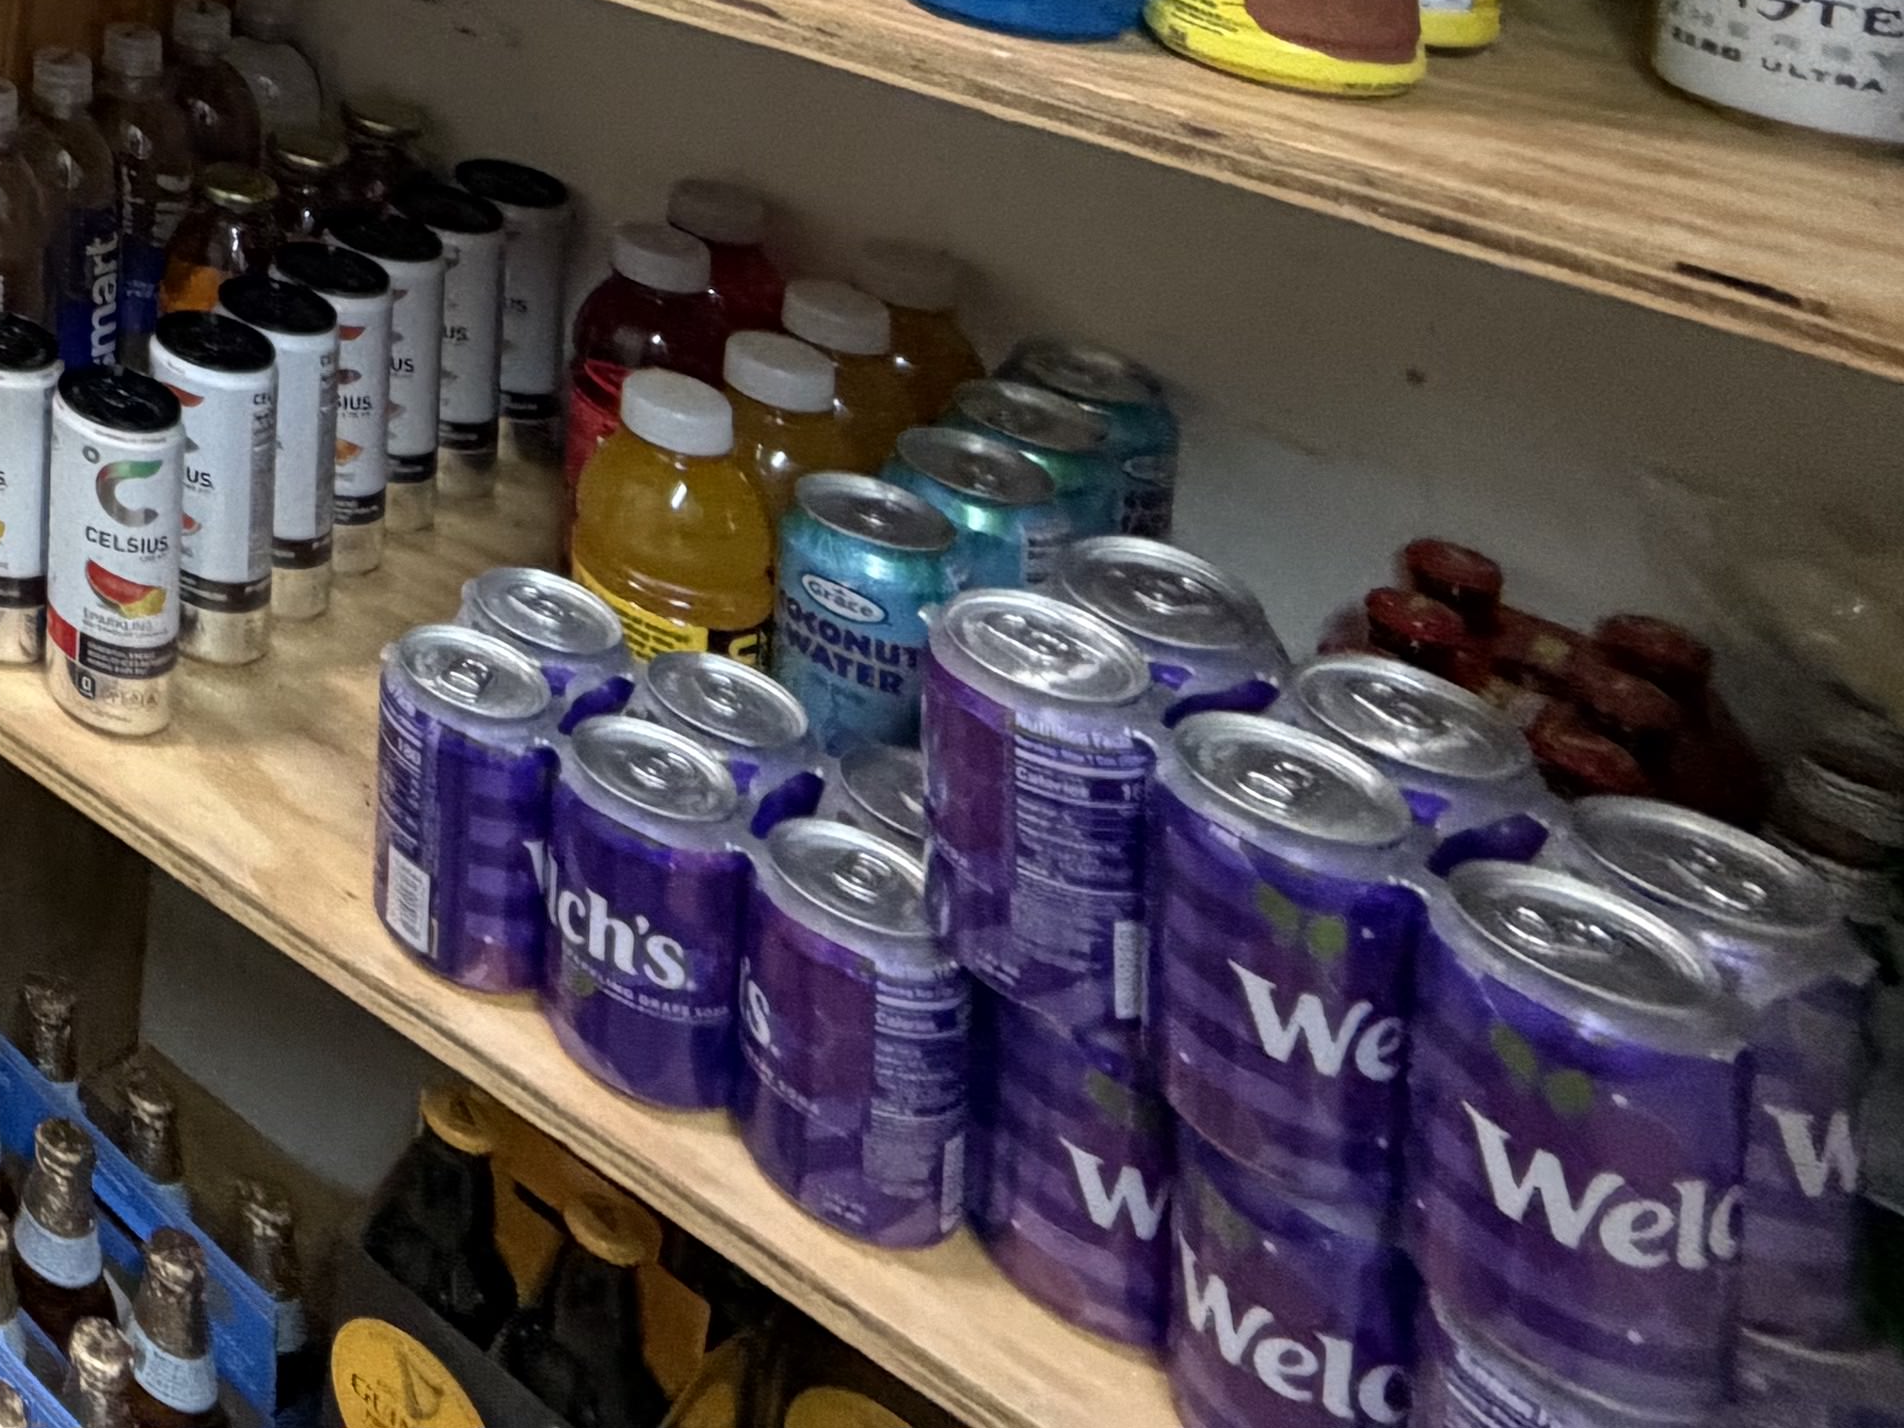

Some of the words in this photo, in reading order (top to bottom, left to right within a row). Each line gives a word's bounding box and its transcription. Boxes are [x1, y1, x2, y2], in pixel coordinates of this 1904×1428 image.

[1761, 56, 1886, 95] ULTRA
[85, 525, 169, 555] CELSIUS
[808, 578, 878, 621] Grace
[787, 628, 903, 694] WATER
